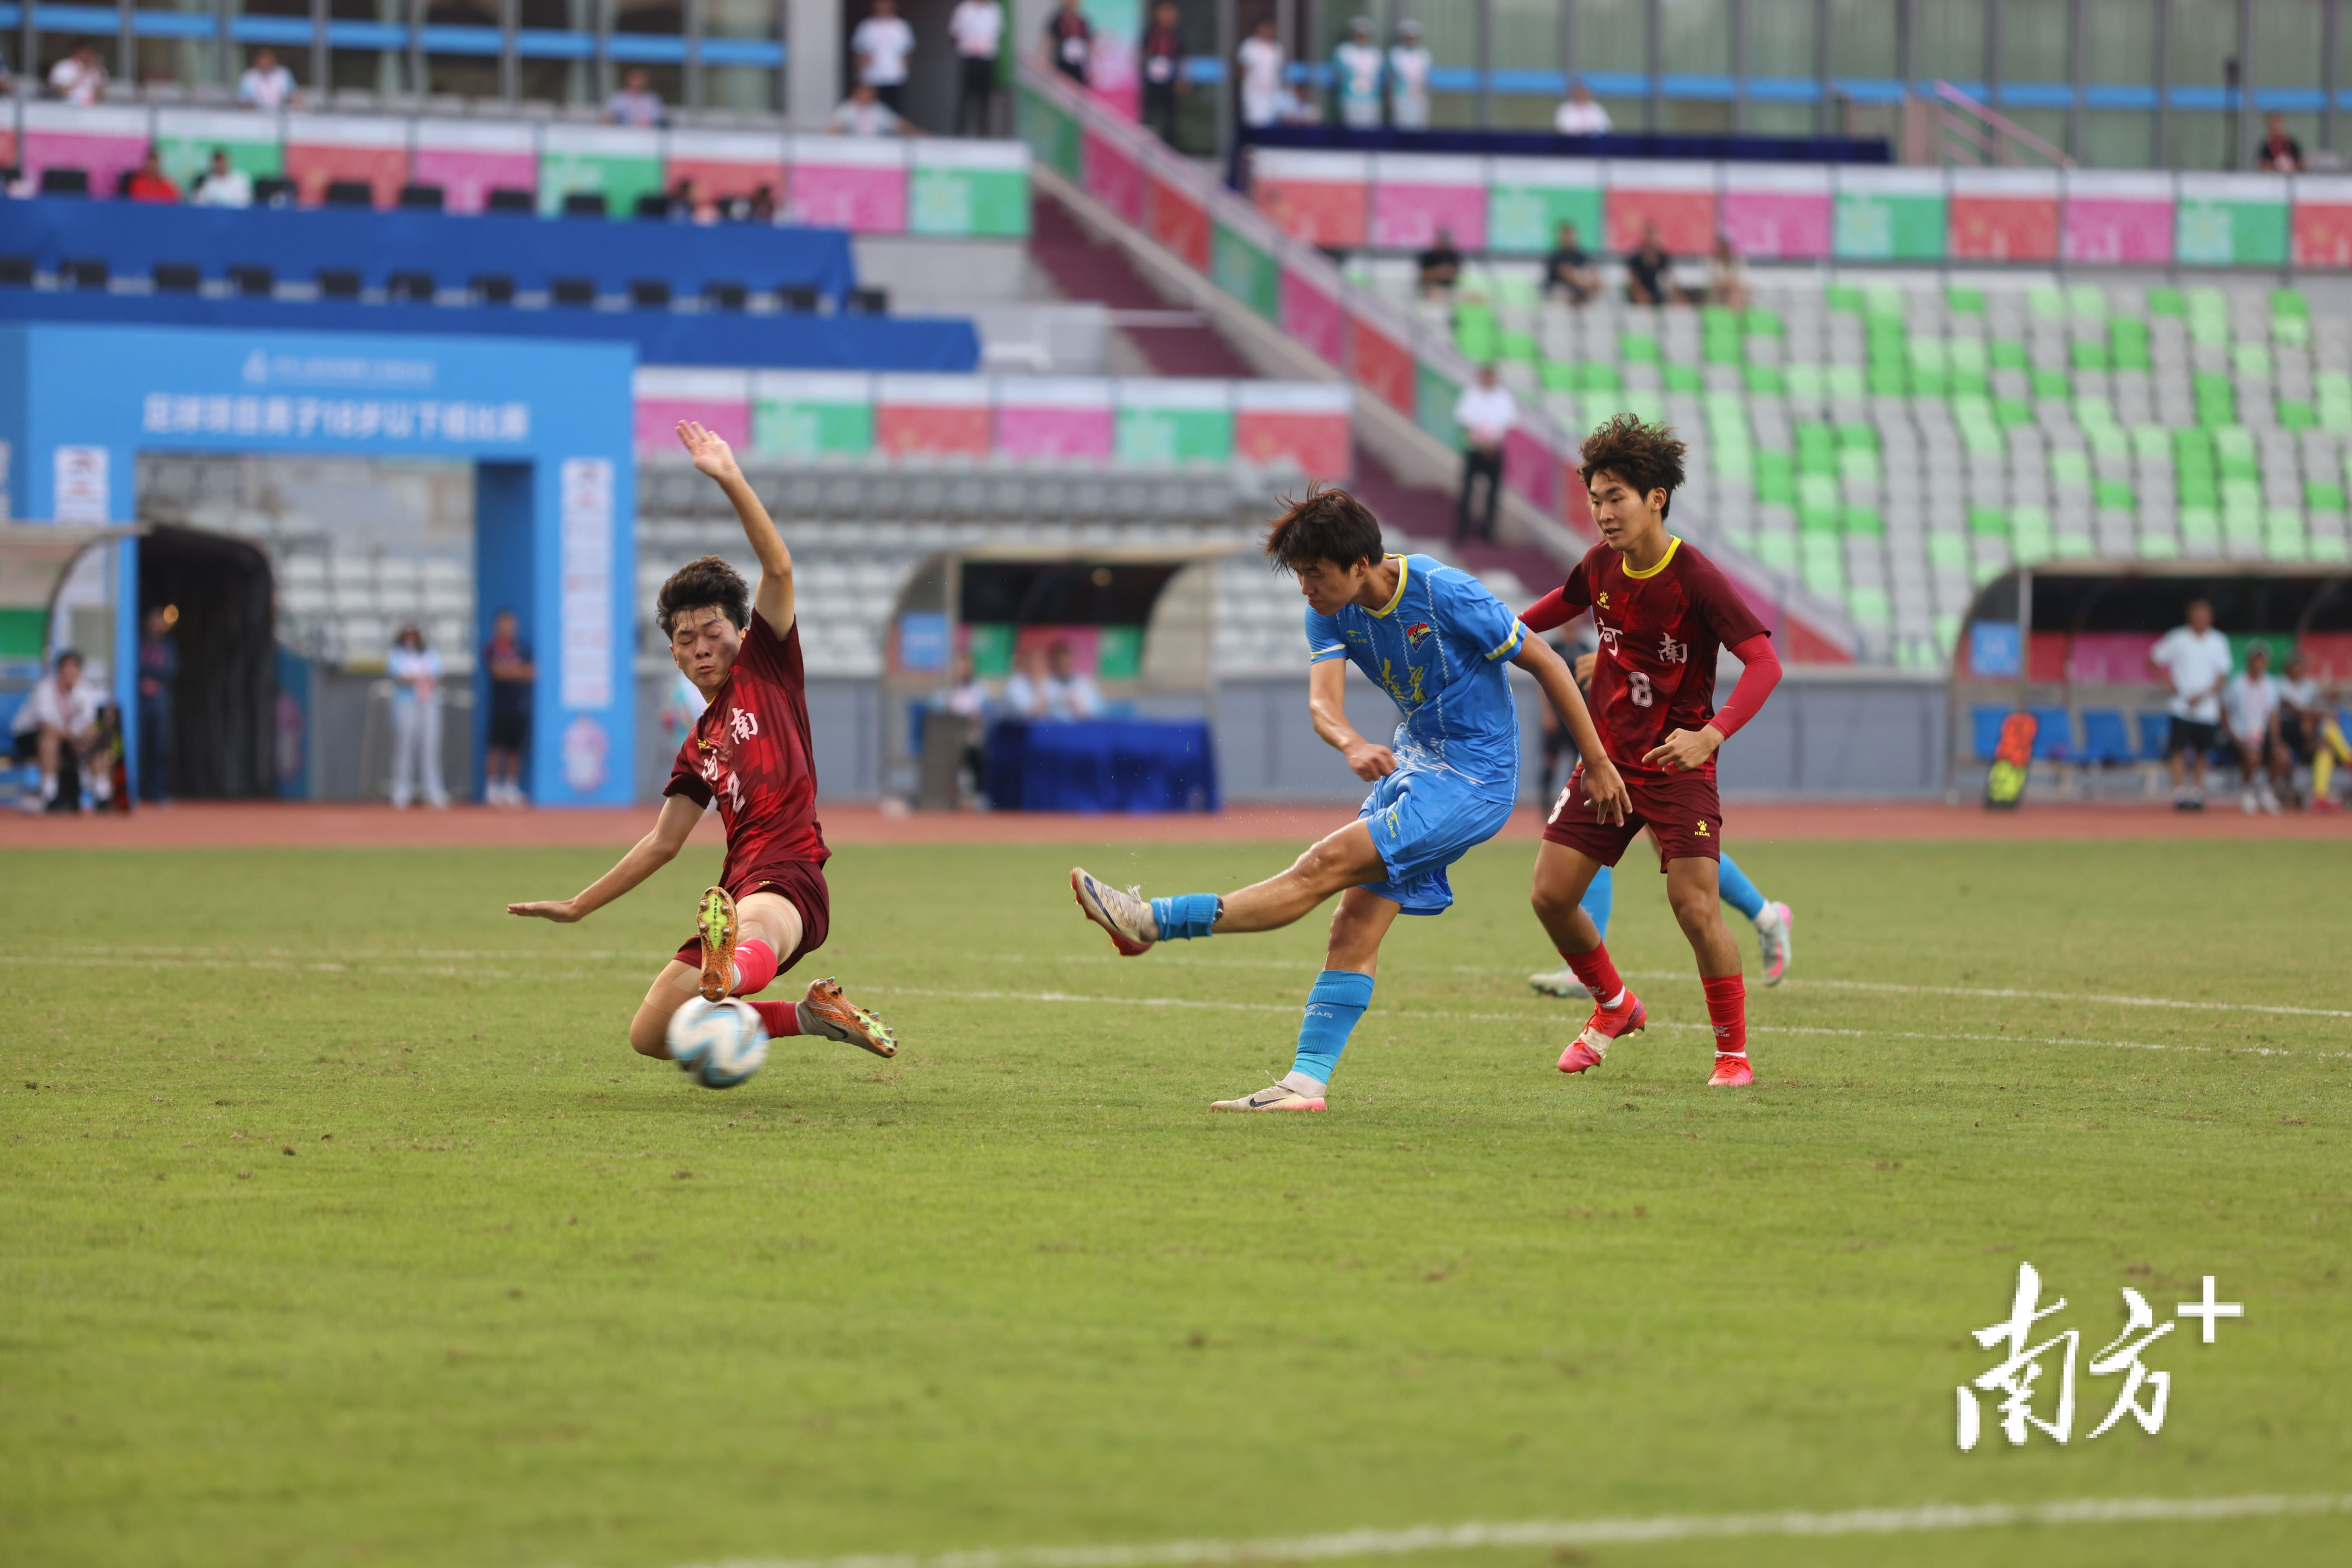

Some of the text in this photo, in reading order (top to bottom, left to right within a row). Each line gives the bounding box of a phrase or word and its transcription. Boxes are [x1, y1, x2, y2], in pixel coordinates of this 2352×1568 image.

[1597, 600, 1610, 610] KELME
[1657, 632, 1688, 664] 南
[1628, 672, 1653, 707] 8
[726, 771, 745, 814] 2
[1547, 787, 1571, 825] 8
